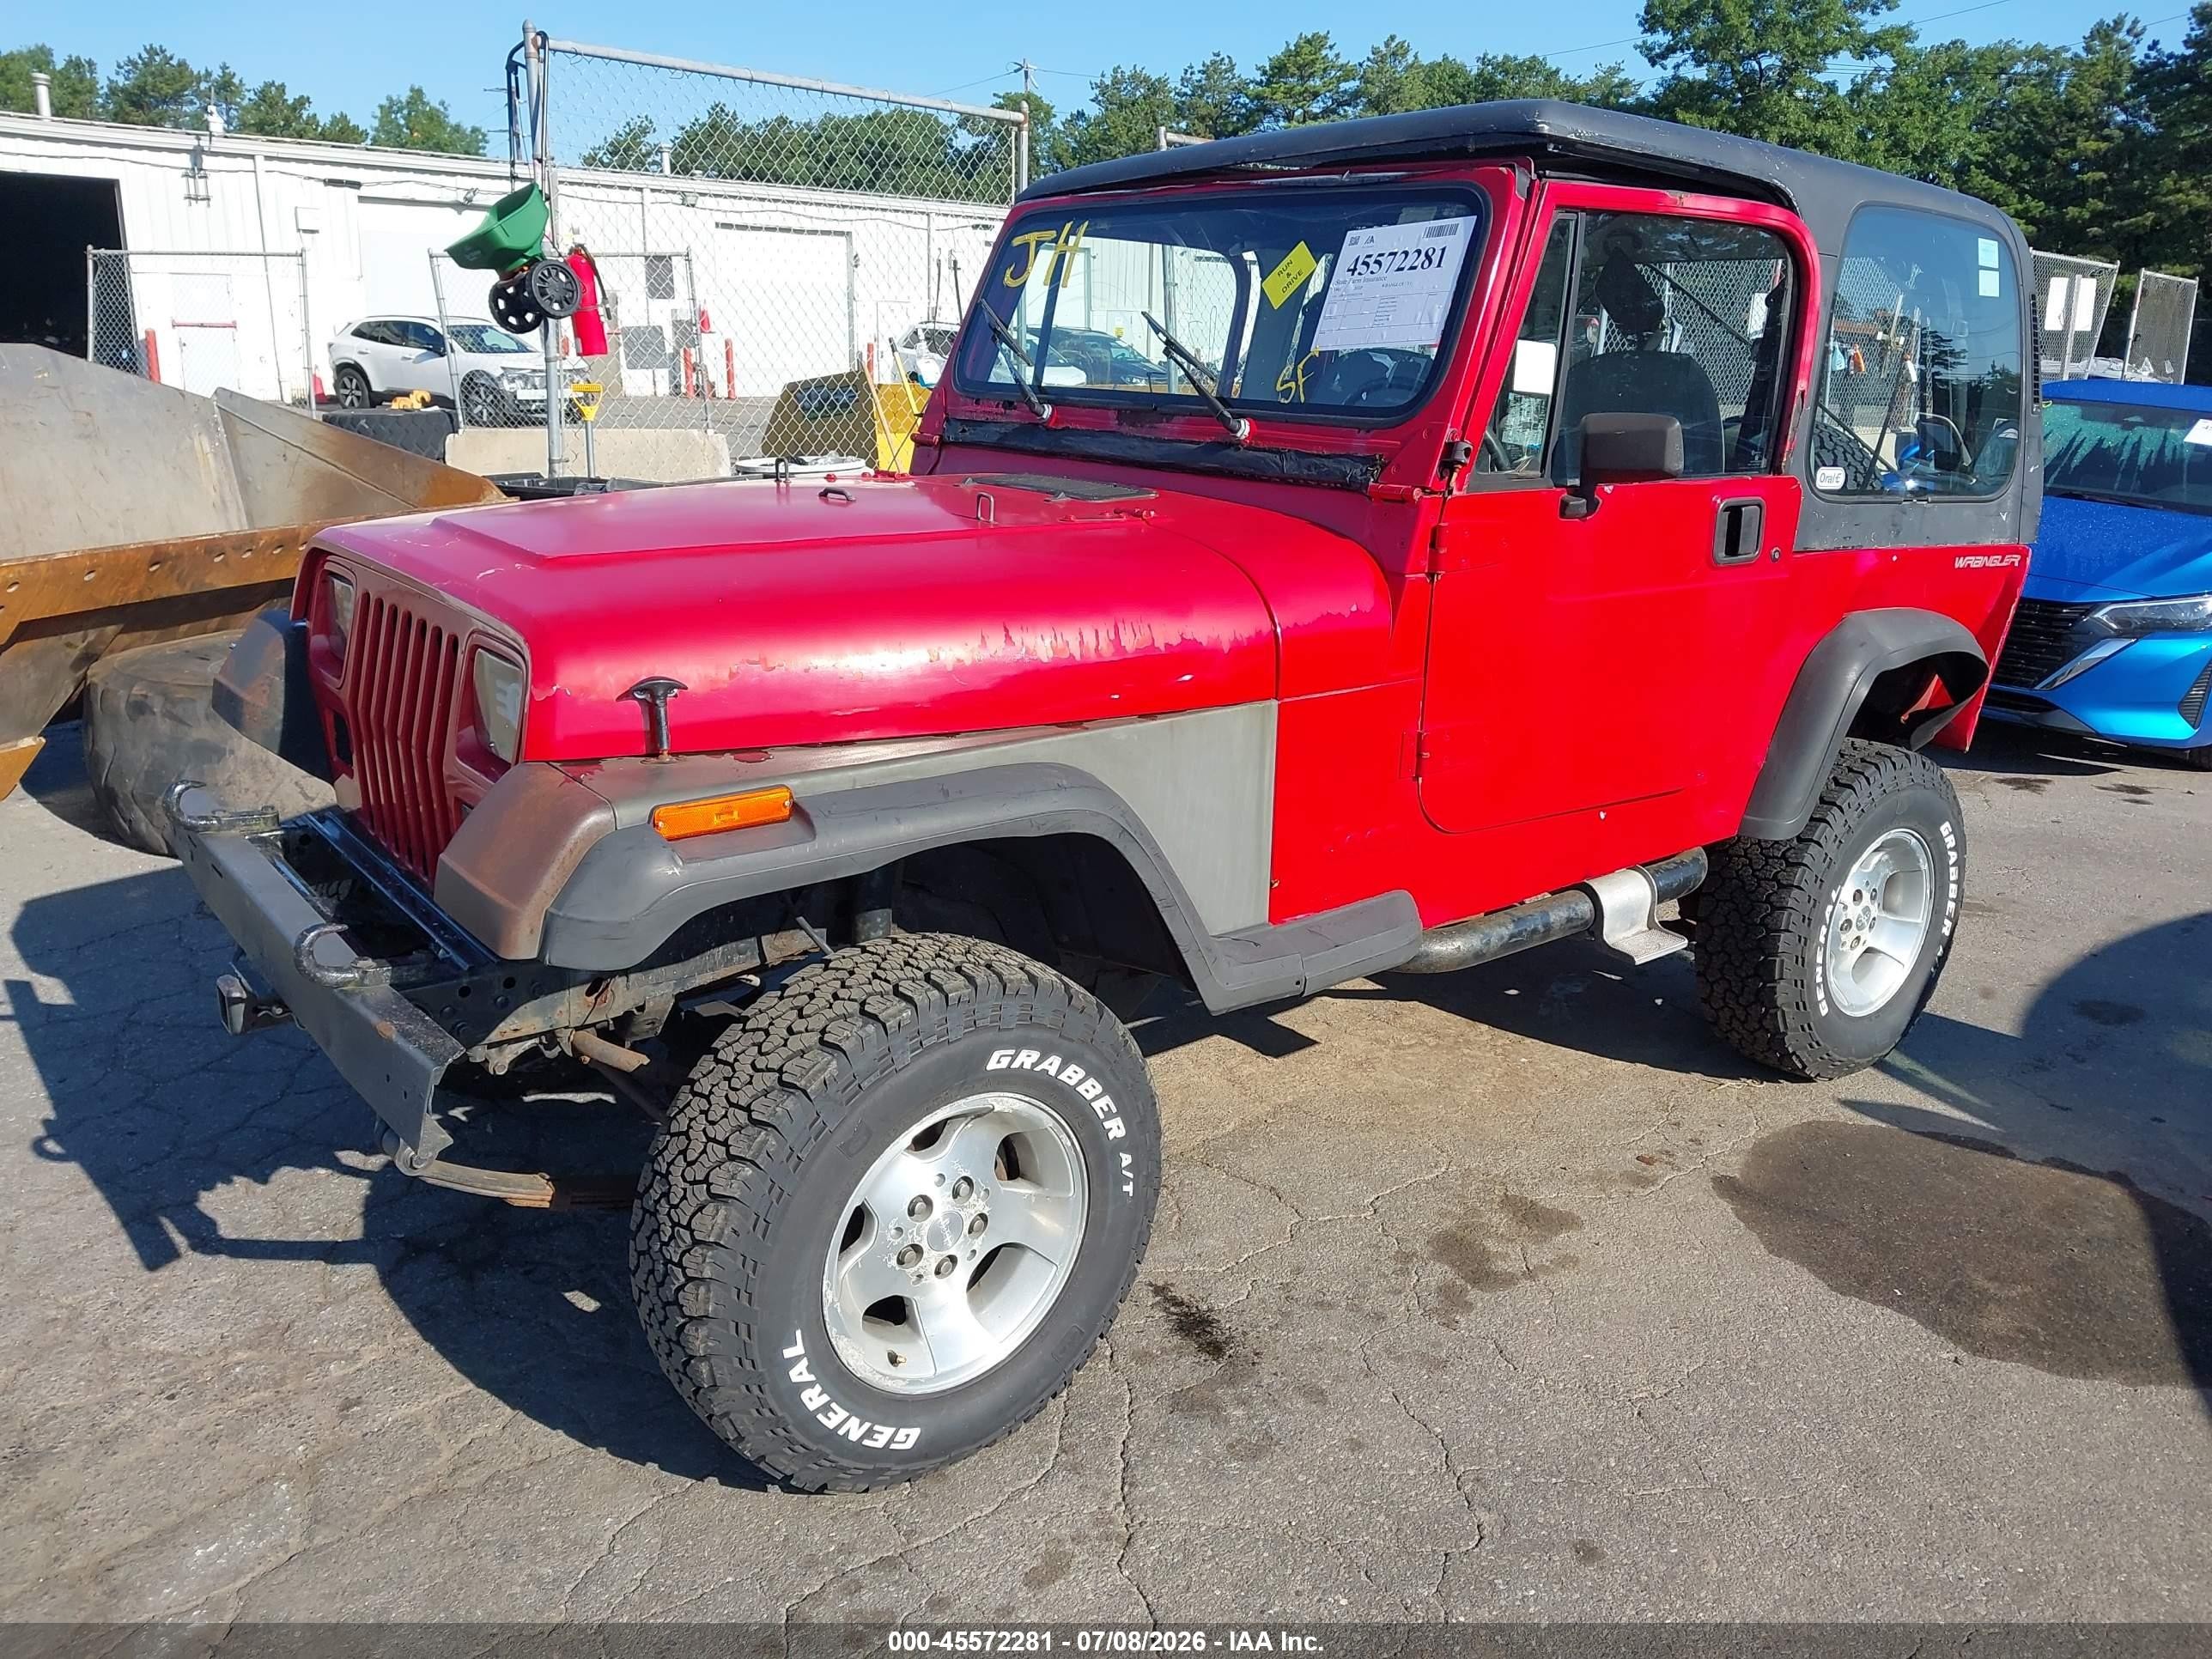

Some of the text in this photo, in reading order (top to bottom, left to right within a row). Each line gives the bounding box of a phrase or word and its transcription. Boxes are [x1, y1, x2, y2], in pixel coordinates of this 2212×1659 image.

[1277, 259, 1293, 277] RUN
[1281, 269, 1304, 294] DRIVE
[1346, 246, 1448, 276] 45572281
[1954, 554, 2021, 568] WRANGLER
[1939, 821, 1959, 937] GRABBER
[1815, 885, 1841, 1017] GENERAL
[986, 1049, 1133, 1197] GRABBER A/T
[782, 1328, 921, 1450] GENERAL
